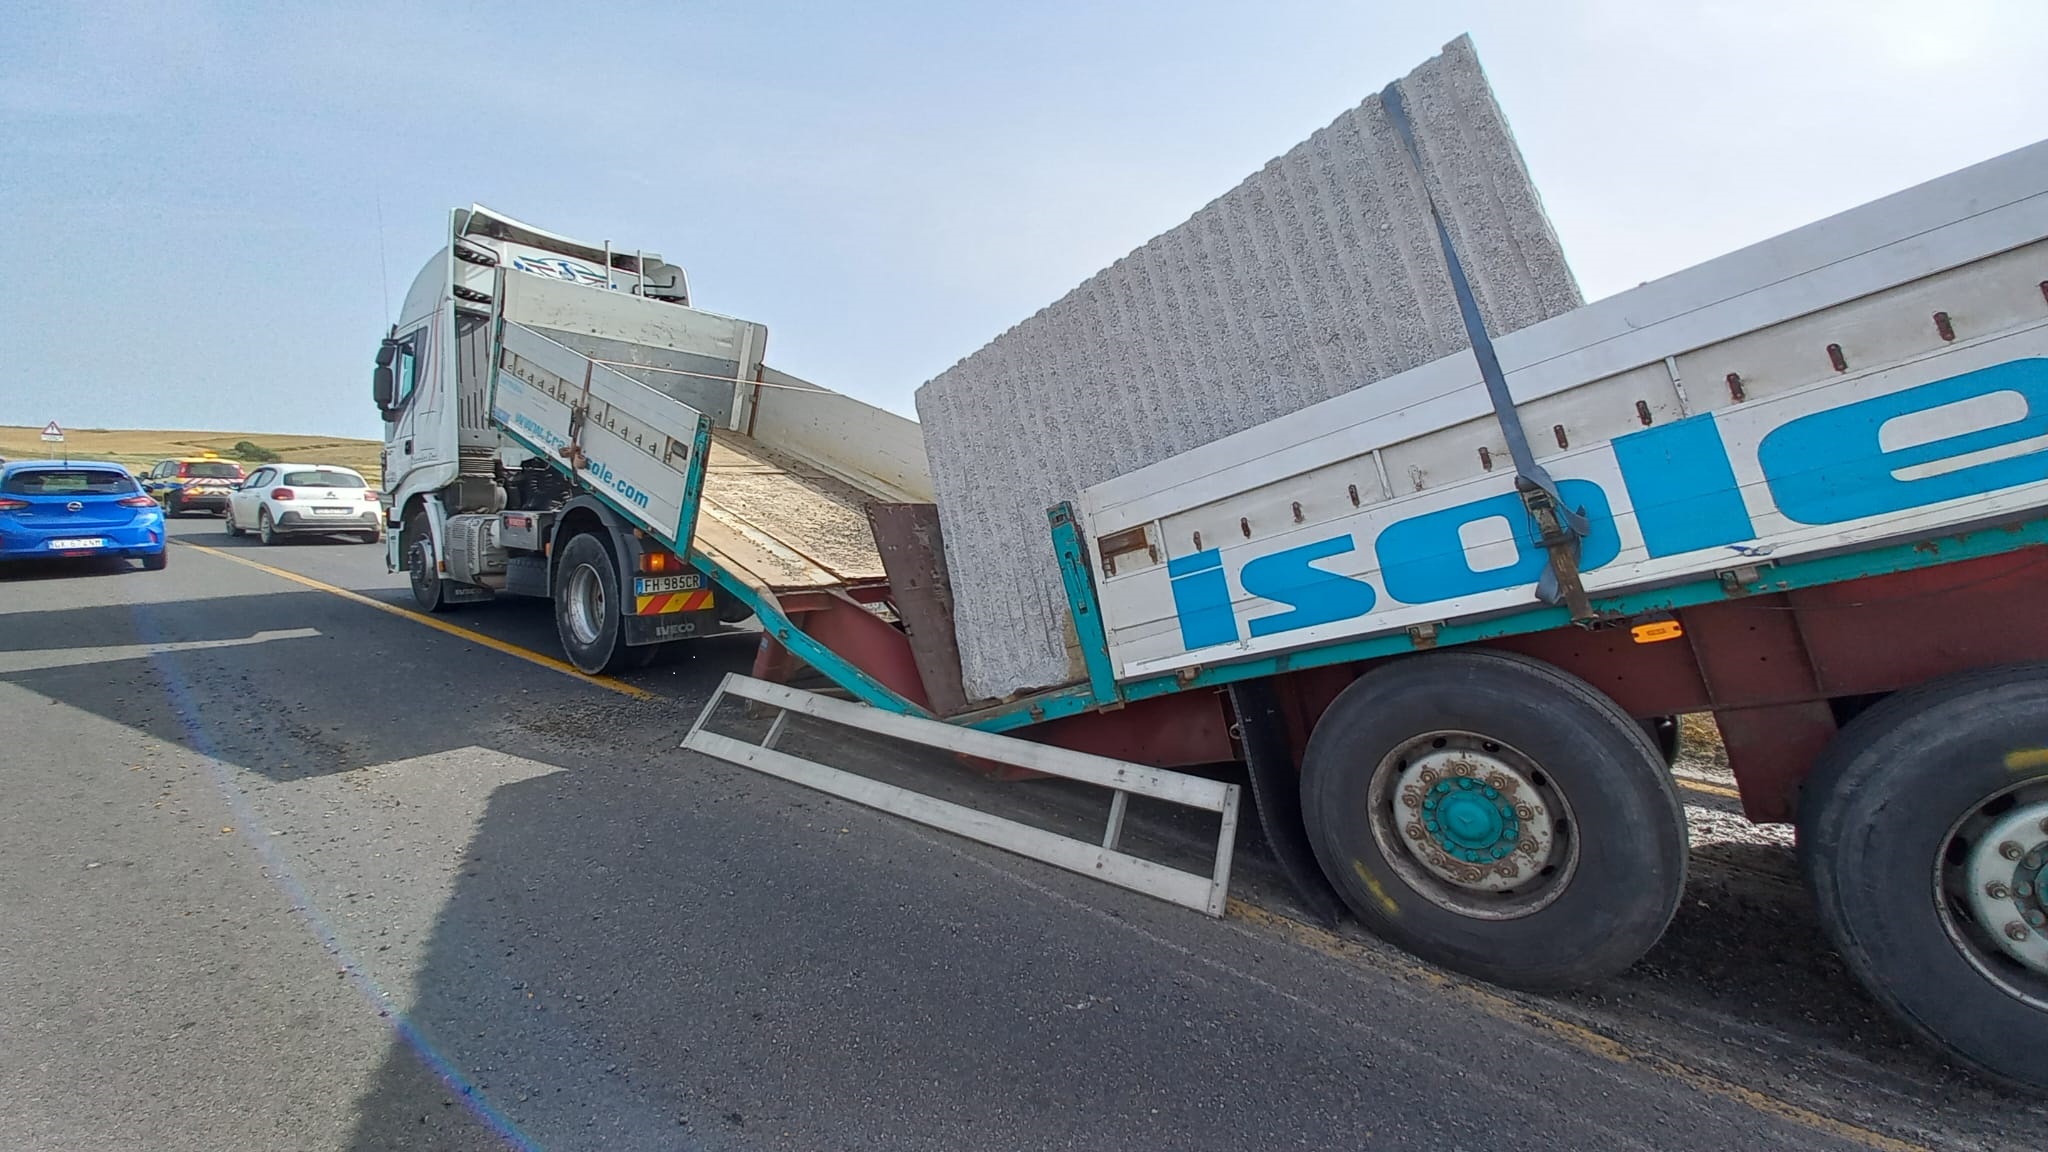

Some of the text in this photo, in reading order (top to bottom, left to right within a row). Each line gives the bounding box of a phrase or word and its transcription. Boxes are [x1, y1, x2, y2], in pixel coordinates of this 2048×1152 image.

[1168, 357, 2048, 651] isole
[645, 575, 699, 592] FH 985CR
[656, 622, 695, 636] IVECO
